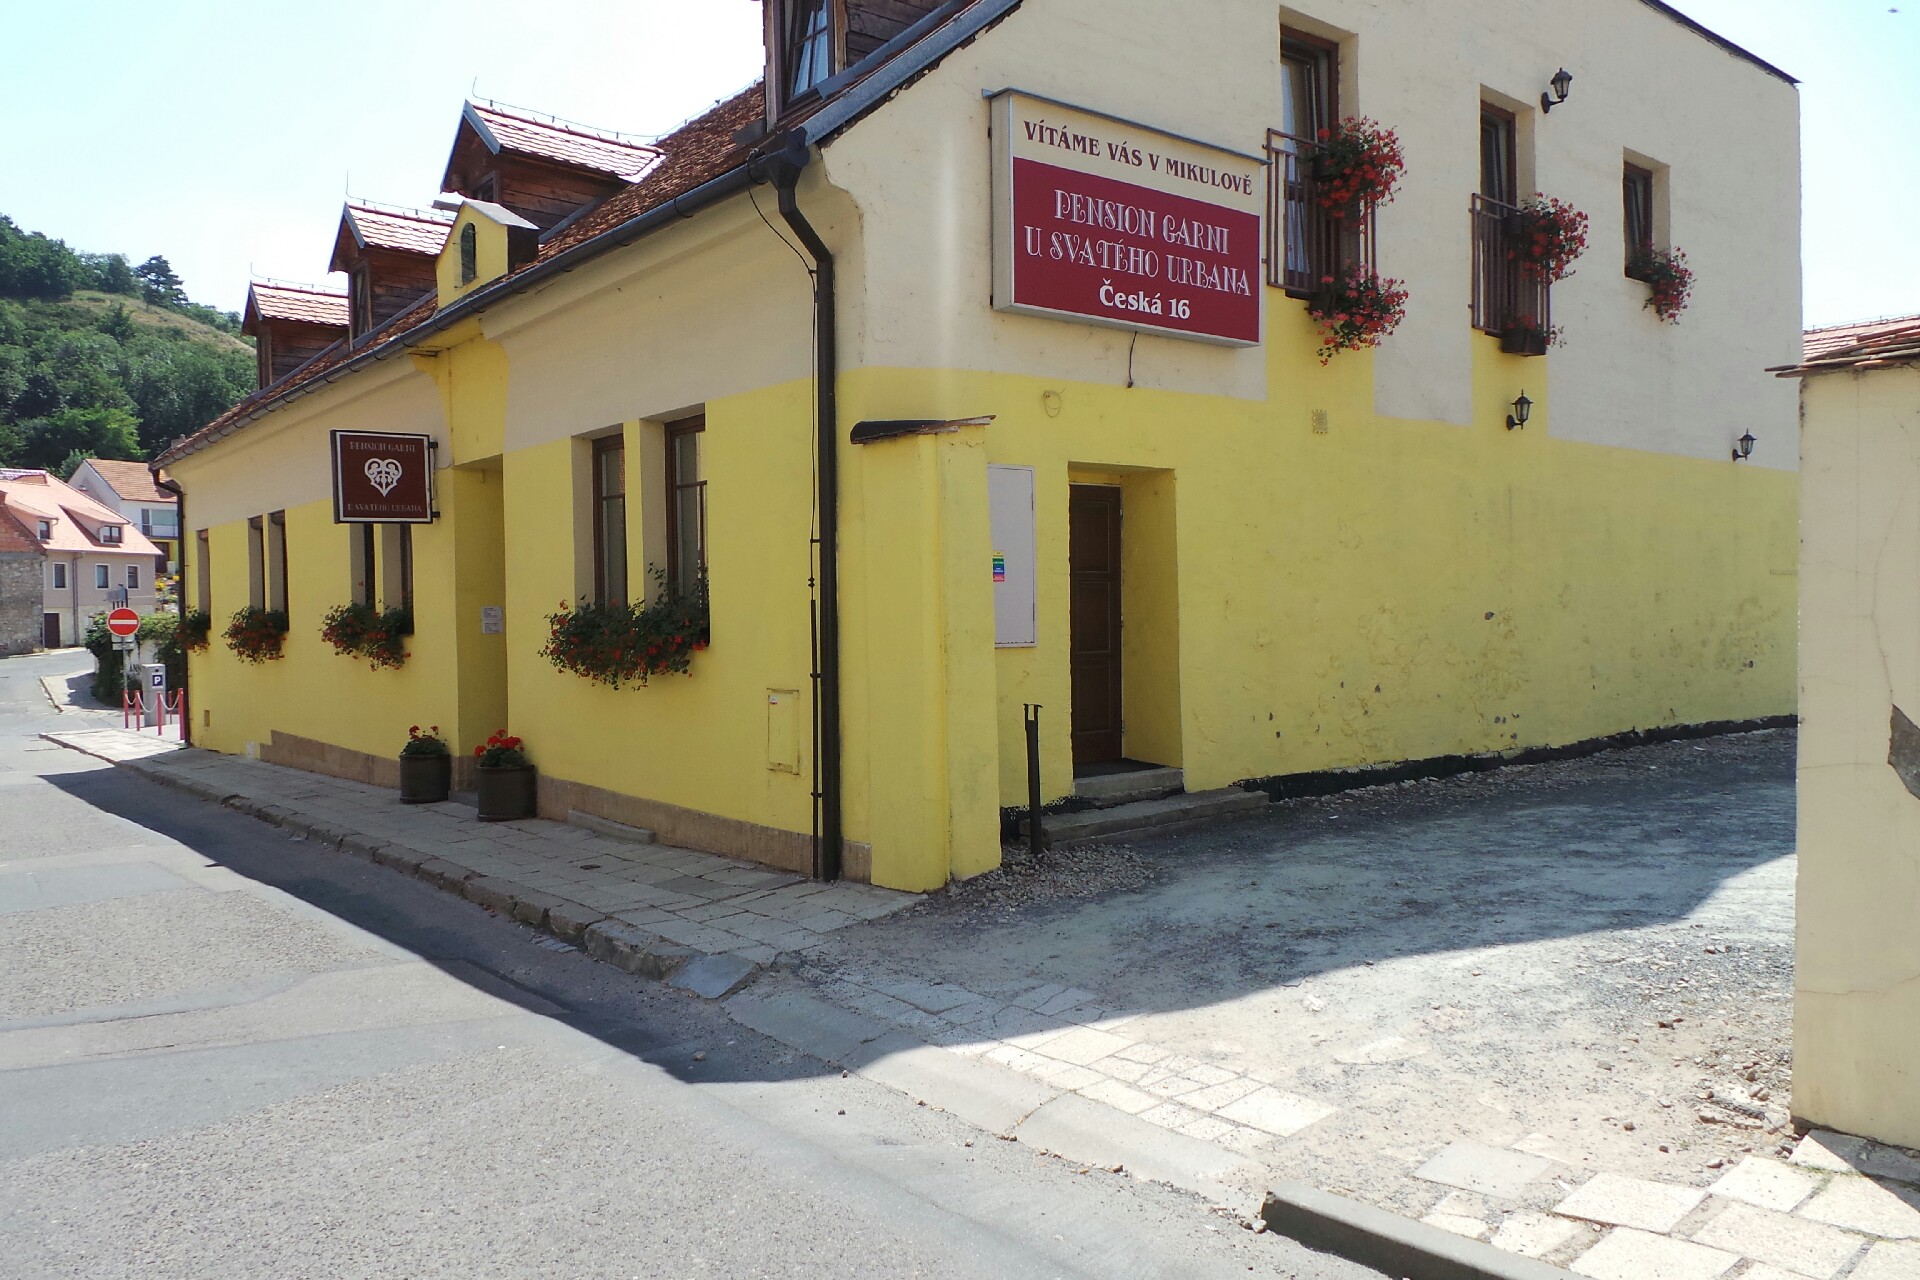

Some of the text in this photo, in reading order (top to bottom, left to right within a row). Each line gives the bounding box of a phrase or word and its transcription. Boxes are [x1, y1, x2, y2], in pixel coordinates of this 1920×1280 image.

[1023, 119, 1253, 196] VÍTÁME VÁS V MIKULOVĚ
[1054, 189, 1230, 255] PENSION GARNI
[1024, 225, 1252, 297] U SVATÉHO URBANA
[1099, 278, 1191, 320] Česká 16
[154, 676, 162, 685] P
